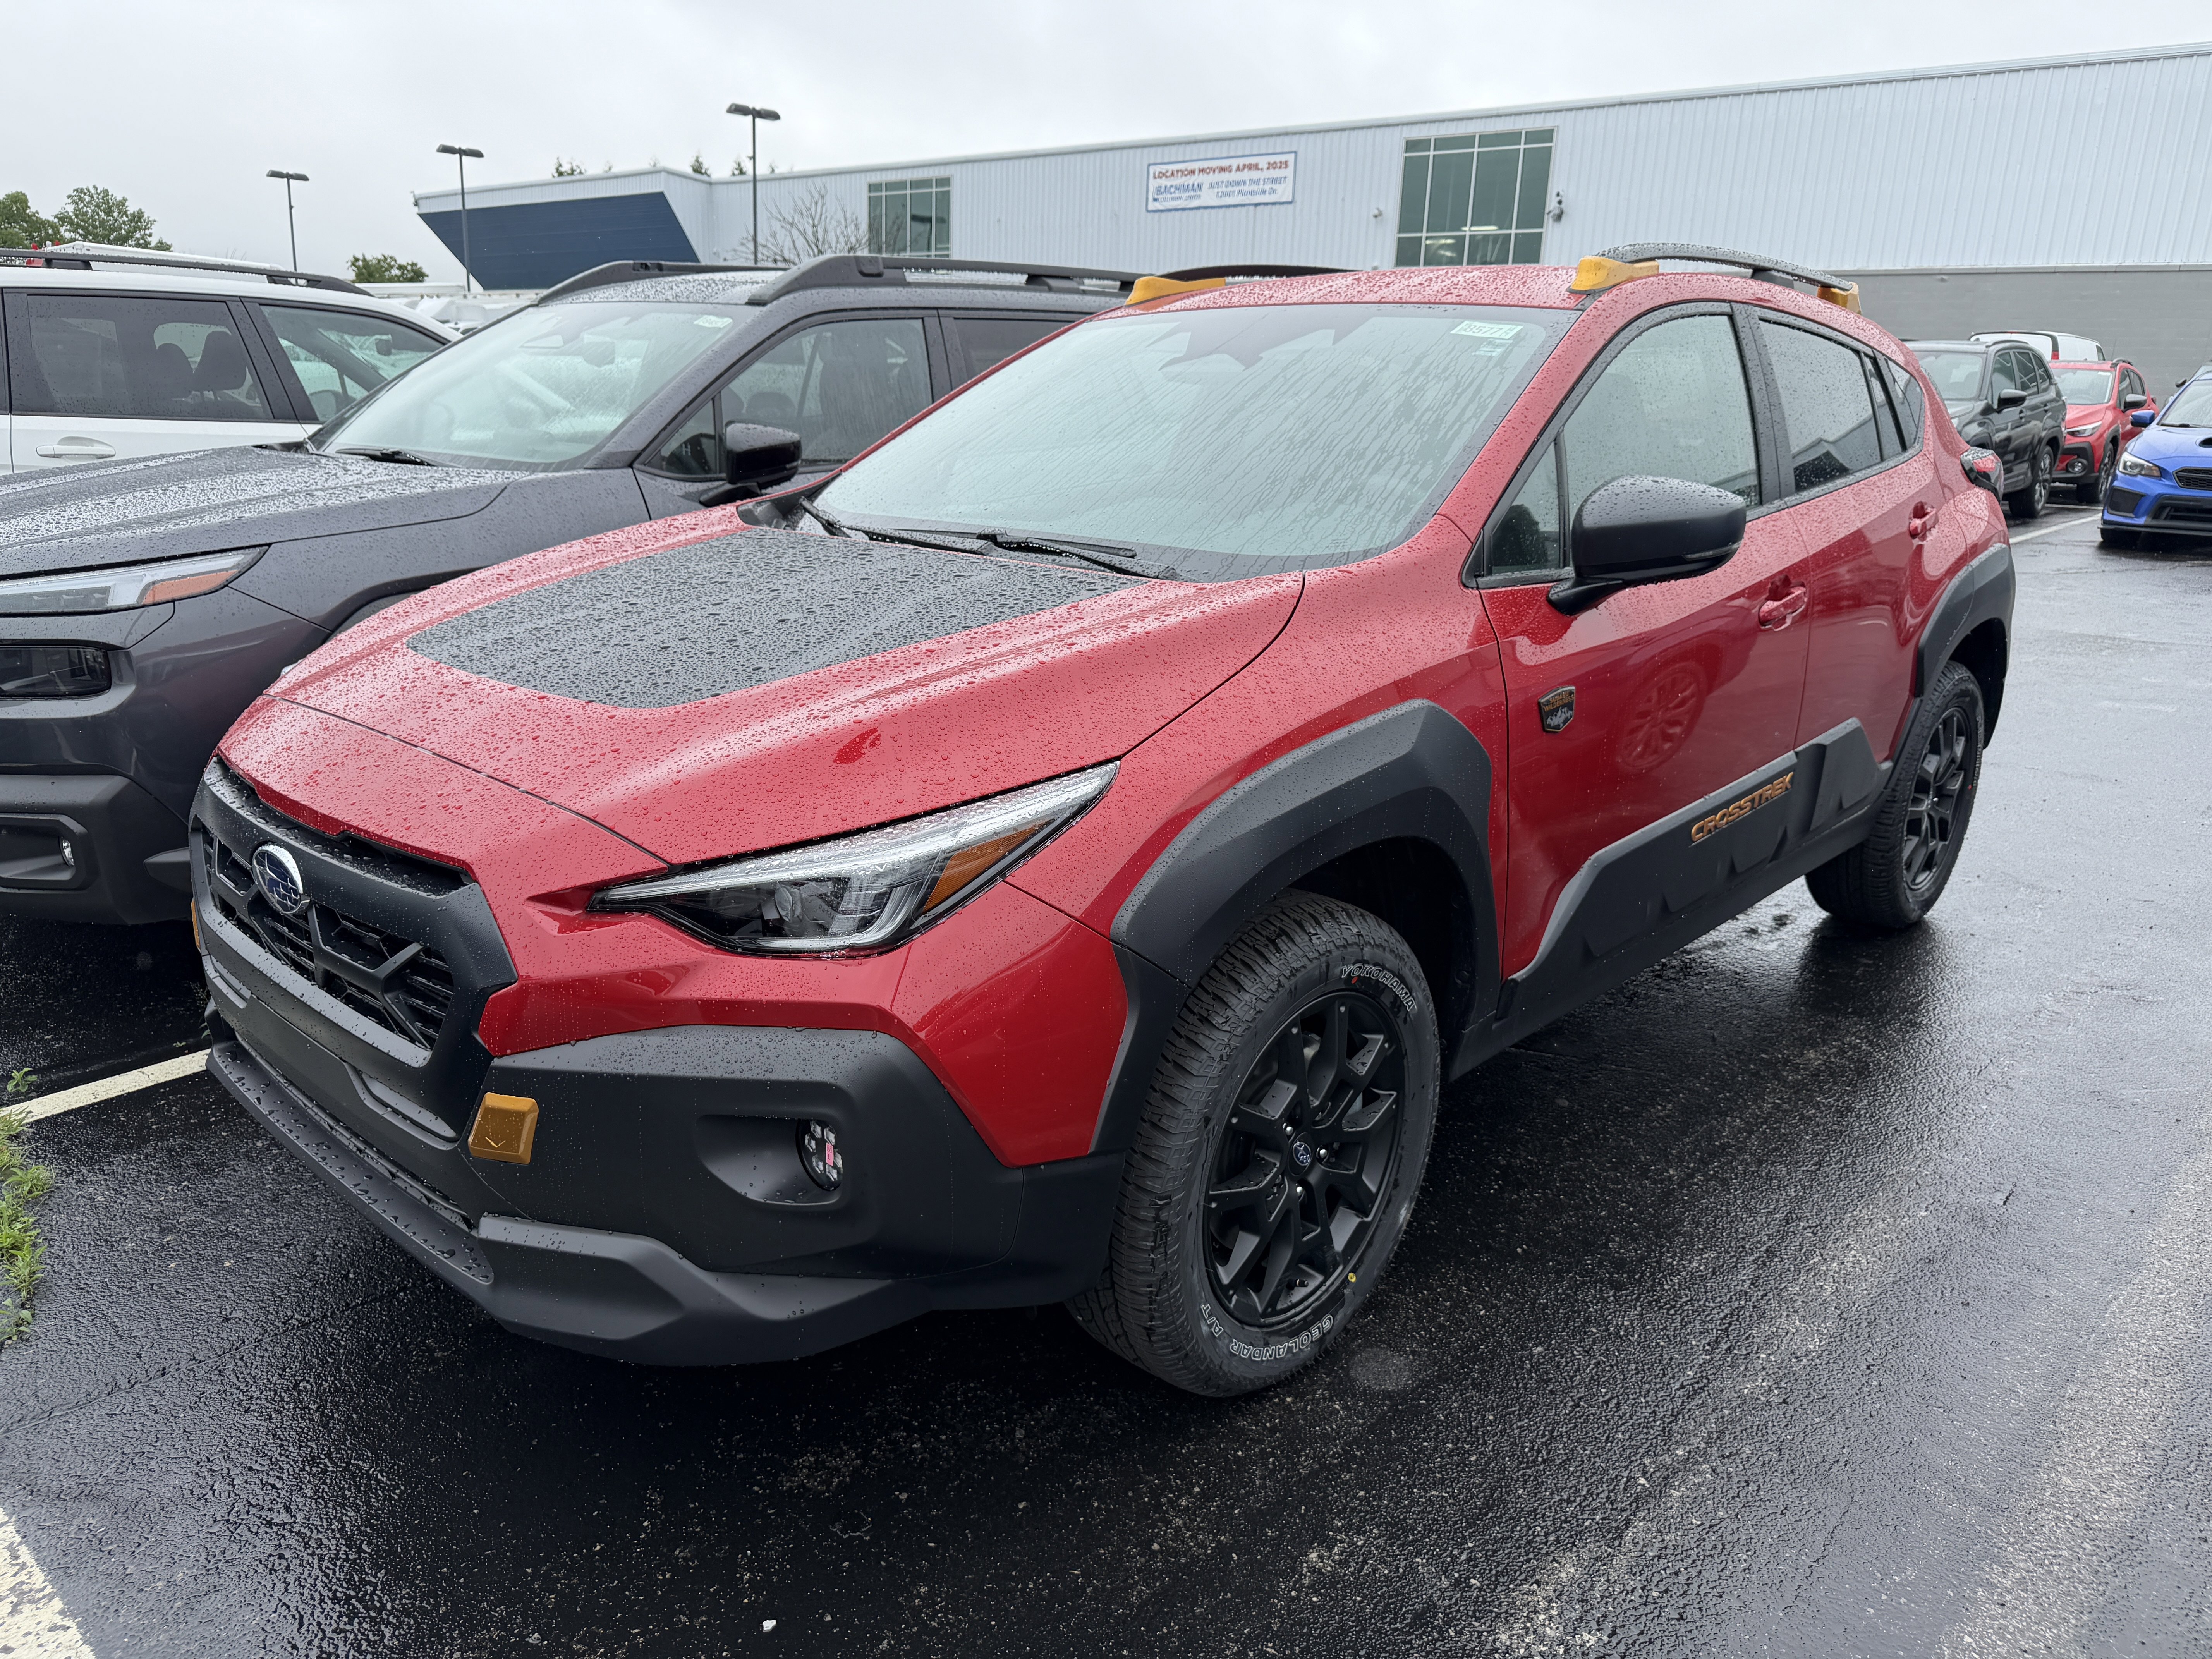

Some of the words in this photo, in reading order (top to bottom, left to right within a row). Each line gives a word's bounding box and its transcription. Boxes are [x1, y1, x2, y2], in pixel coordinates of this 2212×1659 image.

[1153, 167, 1196, 179] LOCATION
[1198, 165, 1233, 176] MOVING
[1235, 162, 1264, 173] APRIL,
[1266, 160, 1290, 170] 2025
[1155, 182, 1204, 196] BACHMAN
[1543, 694, 1574, 712] WILDERNESS
[1691, 771, 1794, 842] CROSSTREK
[1341, 963, 1417, 1012] YOKOHAMA
[1230, 1313, 1334, 1361] GEOLANDAR
